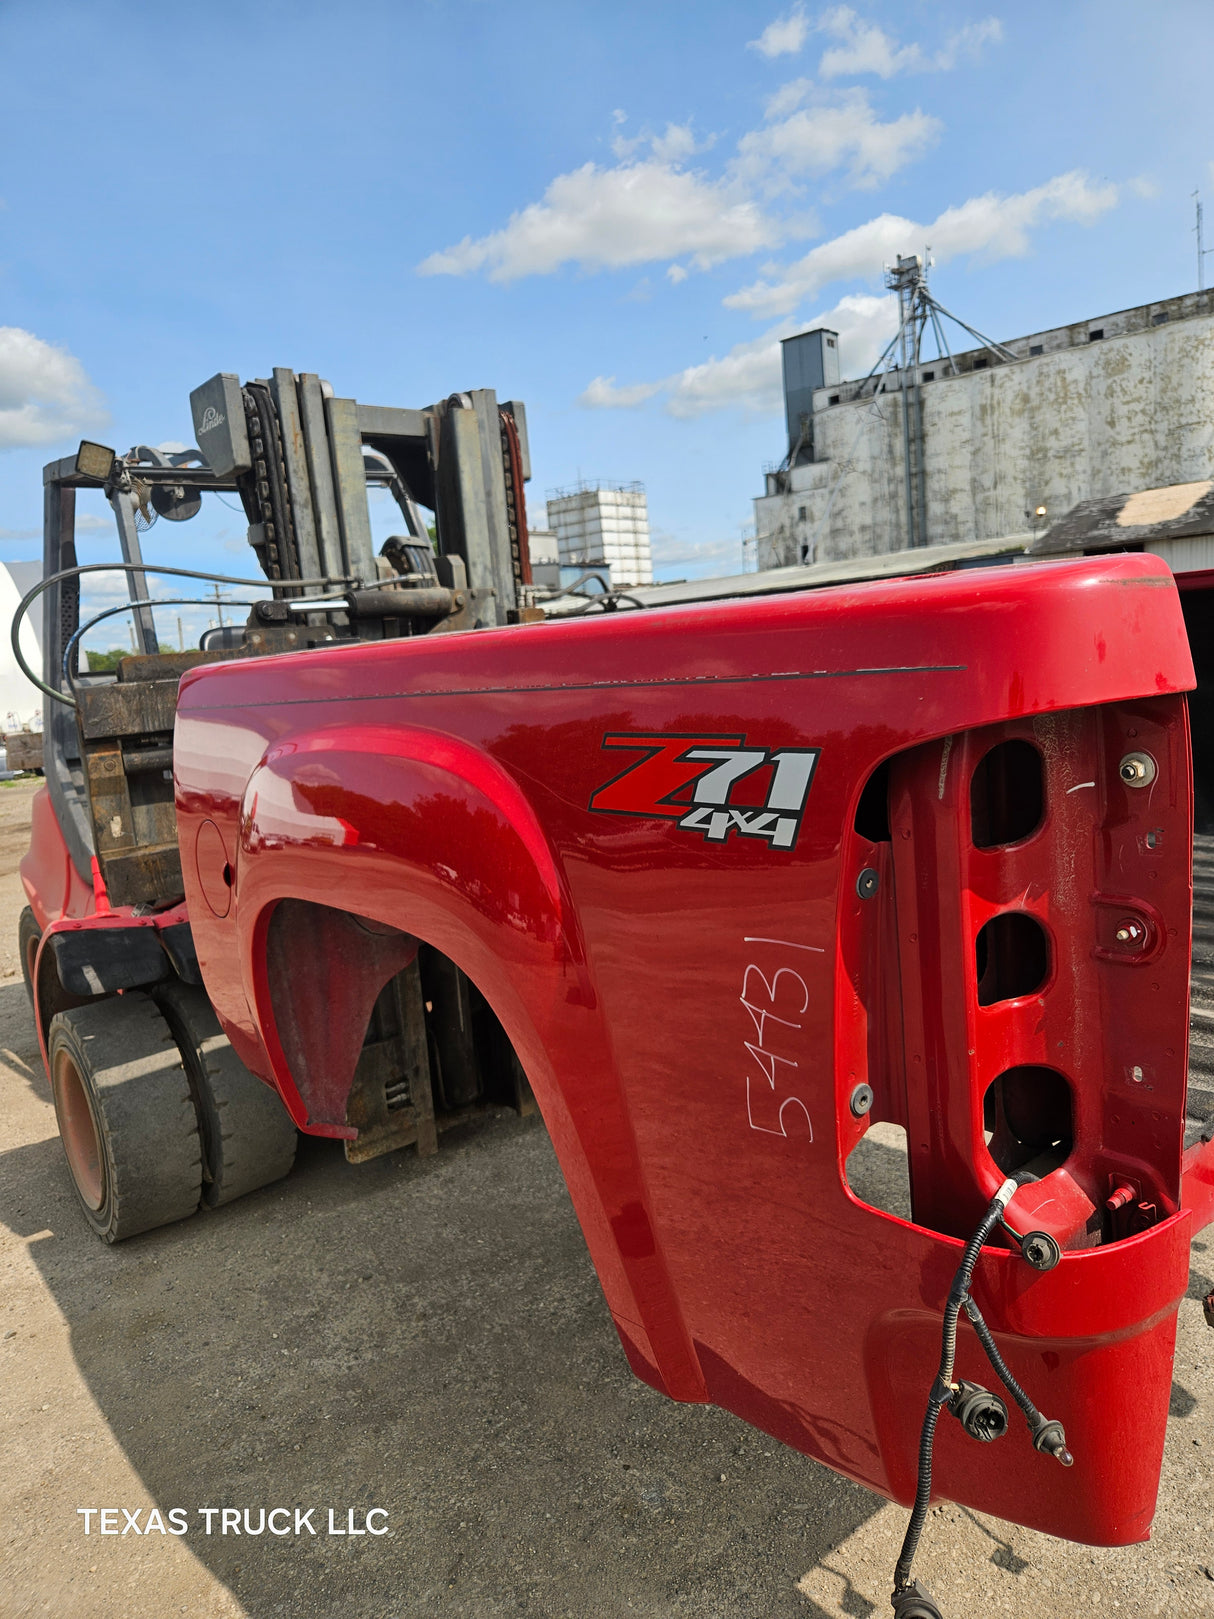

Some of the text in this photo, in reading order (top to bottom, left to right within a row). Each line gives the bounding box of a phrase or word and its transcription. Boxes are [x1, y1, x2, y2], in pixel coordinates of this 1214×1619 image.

[198, 407, 225, 436] Linde
[589, 733, 820, 818] Z71
[740, 937, 825, 1143] 54431
